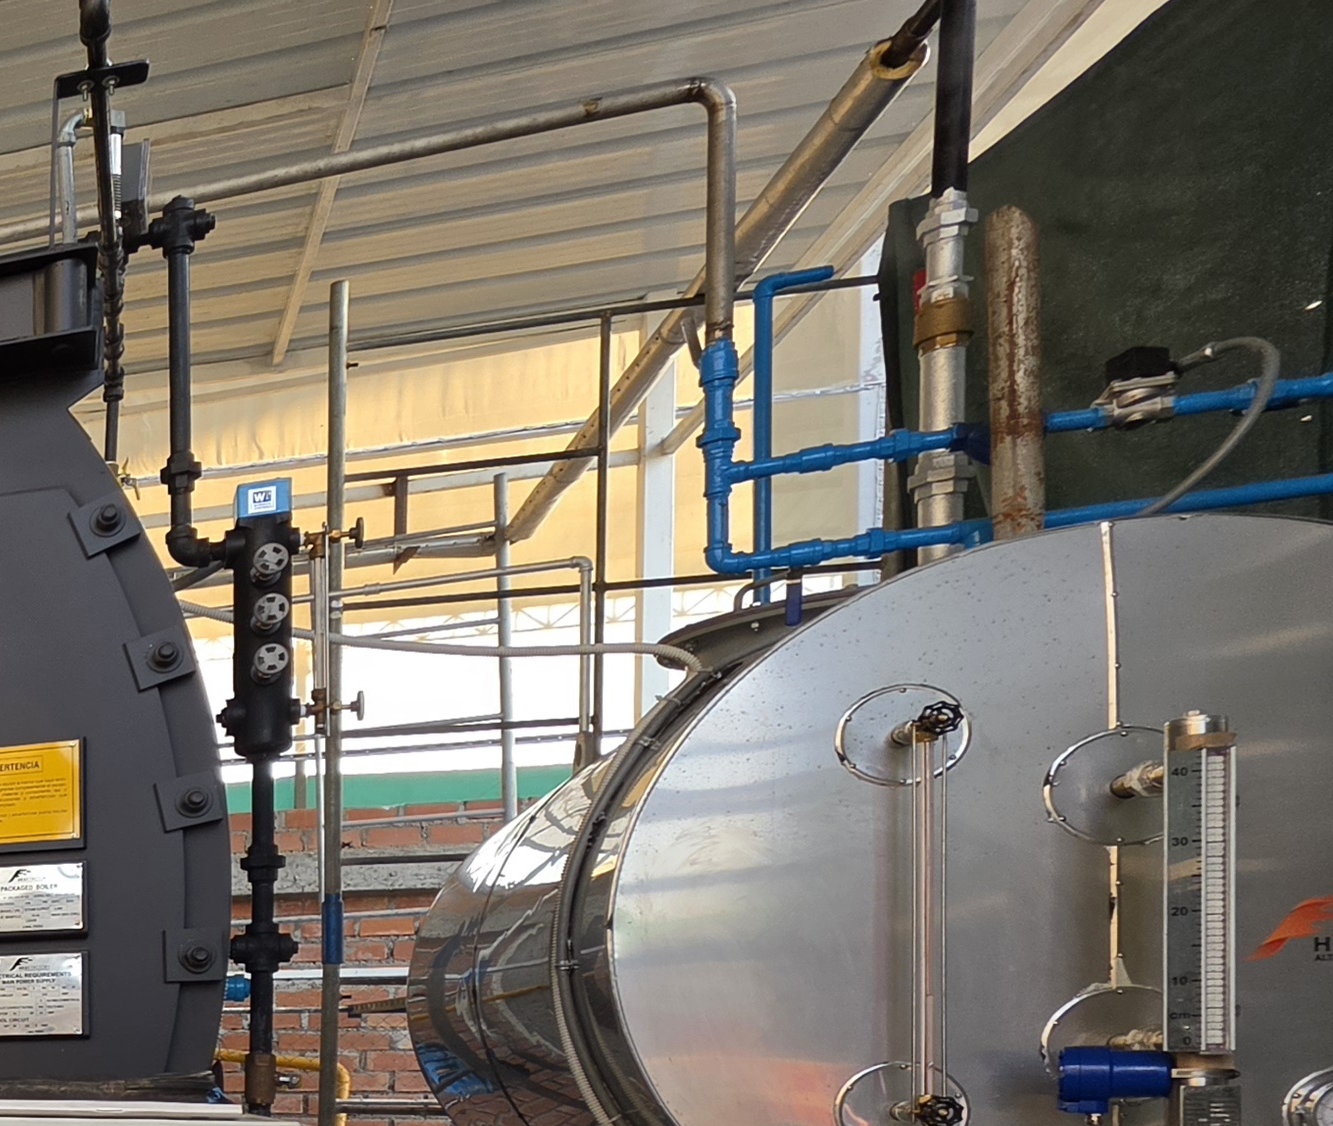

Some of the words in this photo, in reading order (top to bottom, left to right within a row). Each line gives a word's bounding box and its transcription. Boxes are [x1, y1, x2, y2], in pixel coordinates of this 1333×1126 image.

[1172, 767, 1189, 777] 40
[1172, 837, 1189, 847] 30
[0, 884, 33, 892] PACKAGED
[1171, 907, 1189, 917] 20
[1172, 977, 1188, 986] 10
[1183, 1036, 1192, 1046] 0
